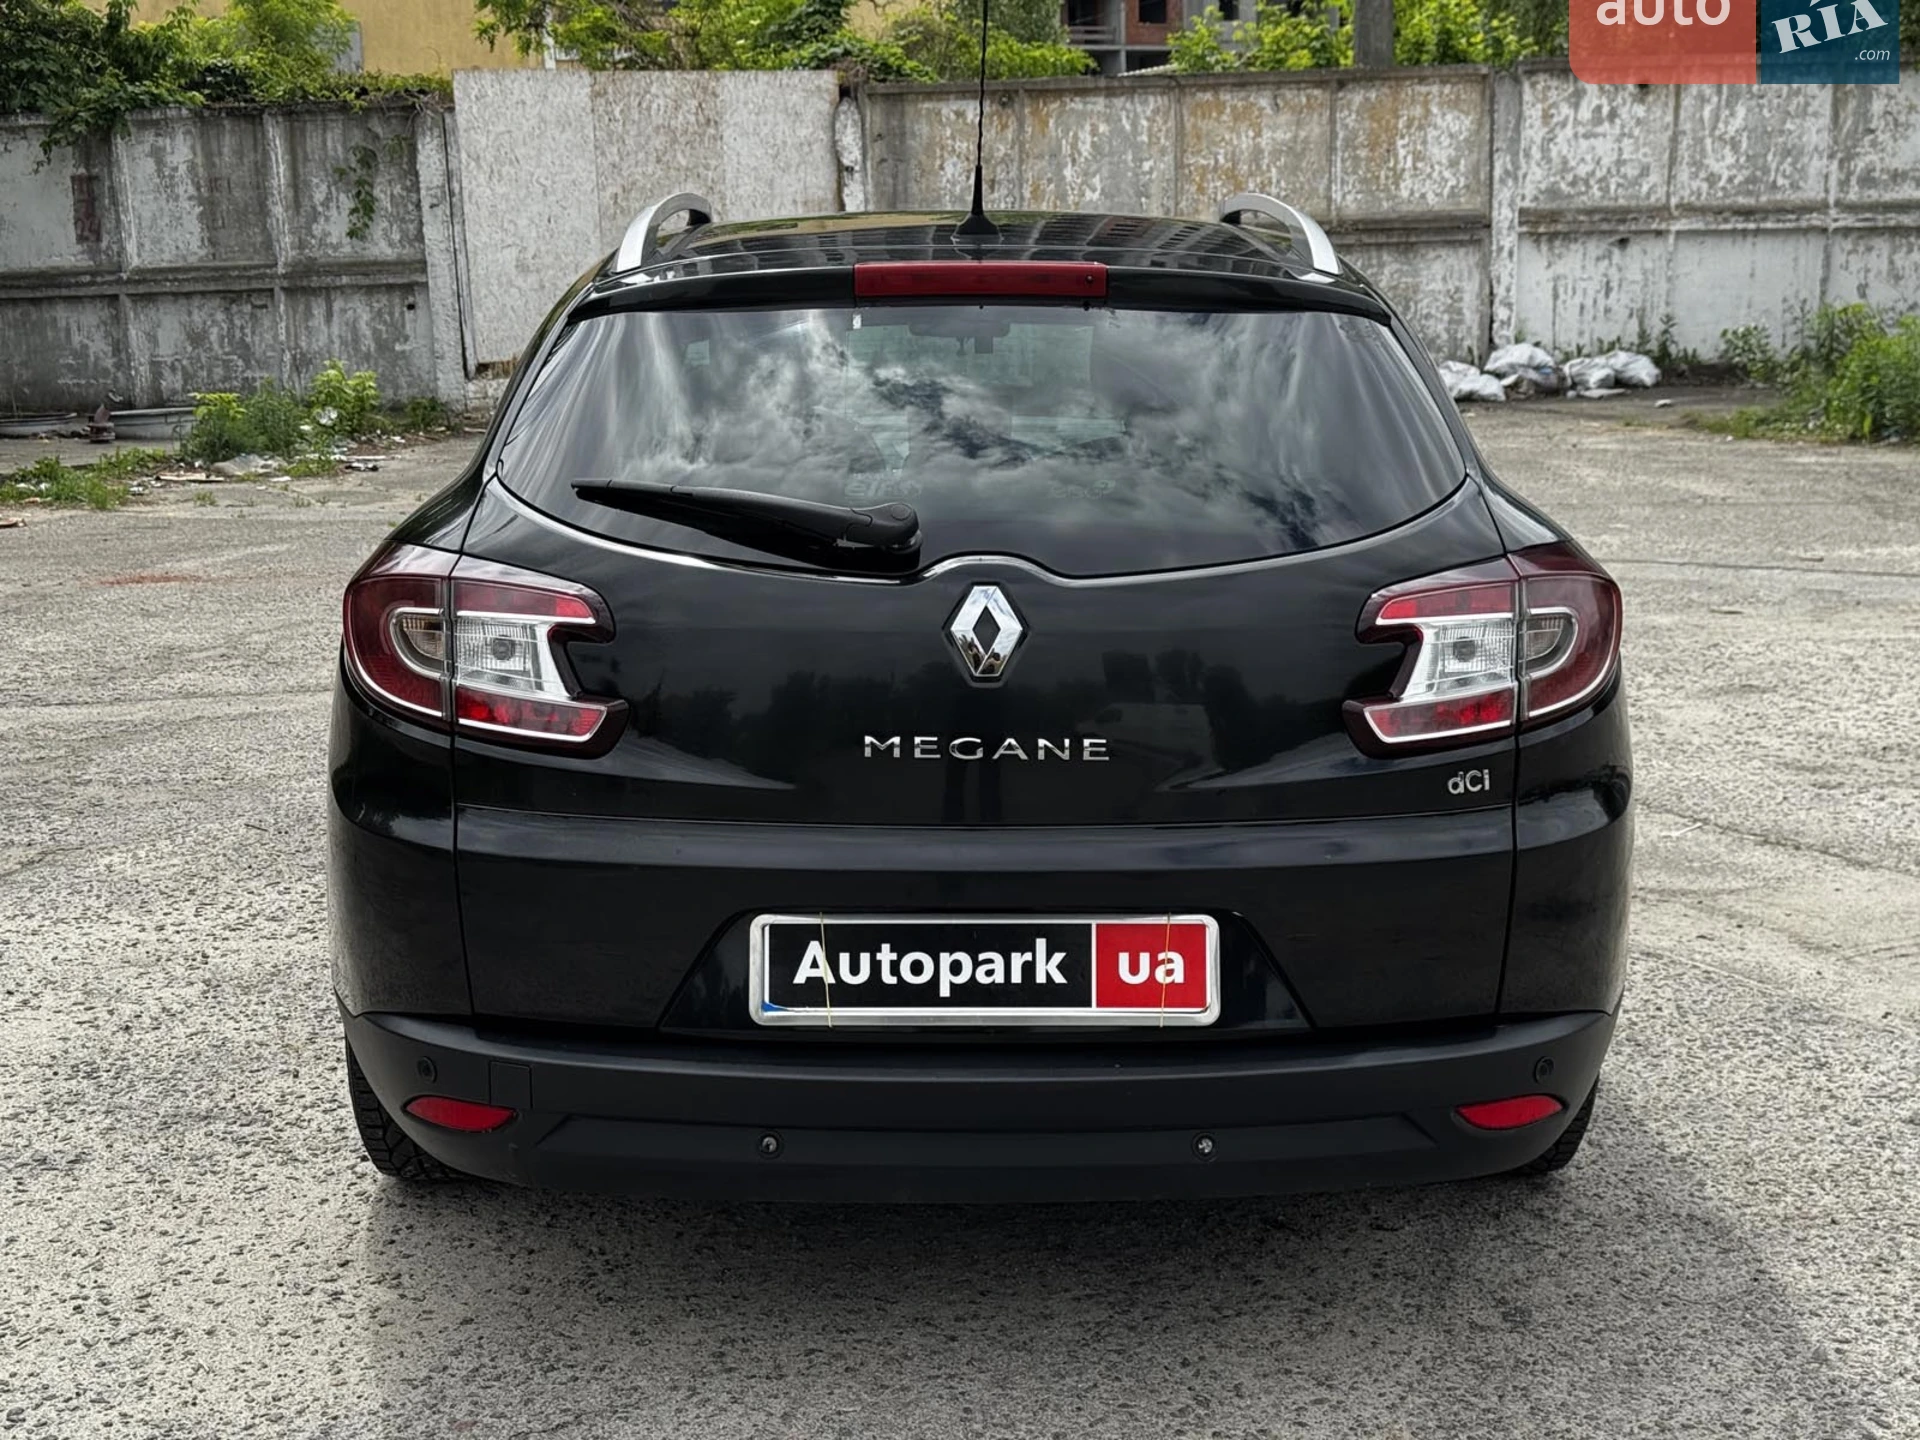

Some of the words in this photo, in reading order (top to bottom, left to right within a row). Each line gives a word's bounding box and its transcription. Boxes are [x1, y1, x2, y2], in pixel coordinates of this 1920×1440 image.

[864, 735, 1110, 761] MEGANE
[1448, 768, 1490, 795] dCi
[792, 938, 1068, 998] Autopark
[1117, 951, 1185, 985] ua
